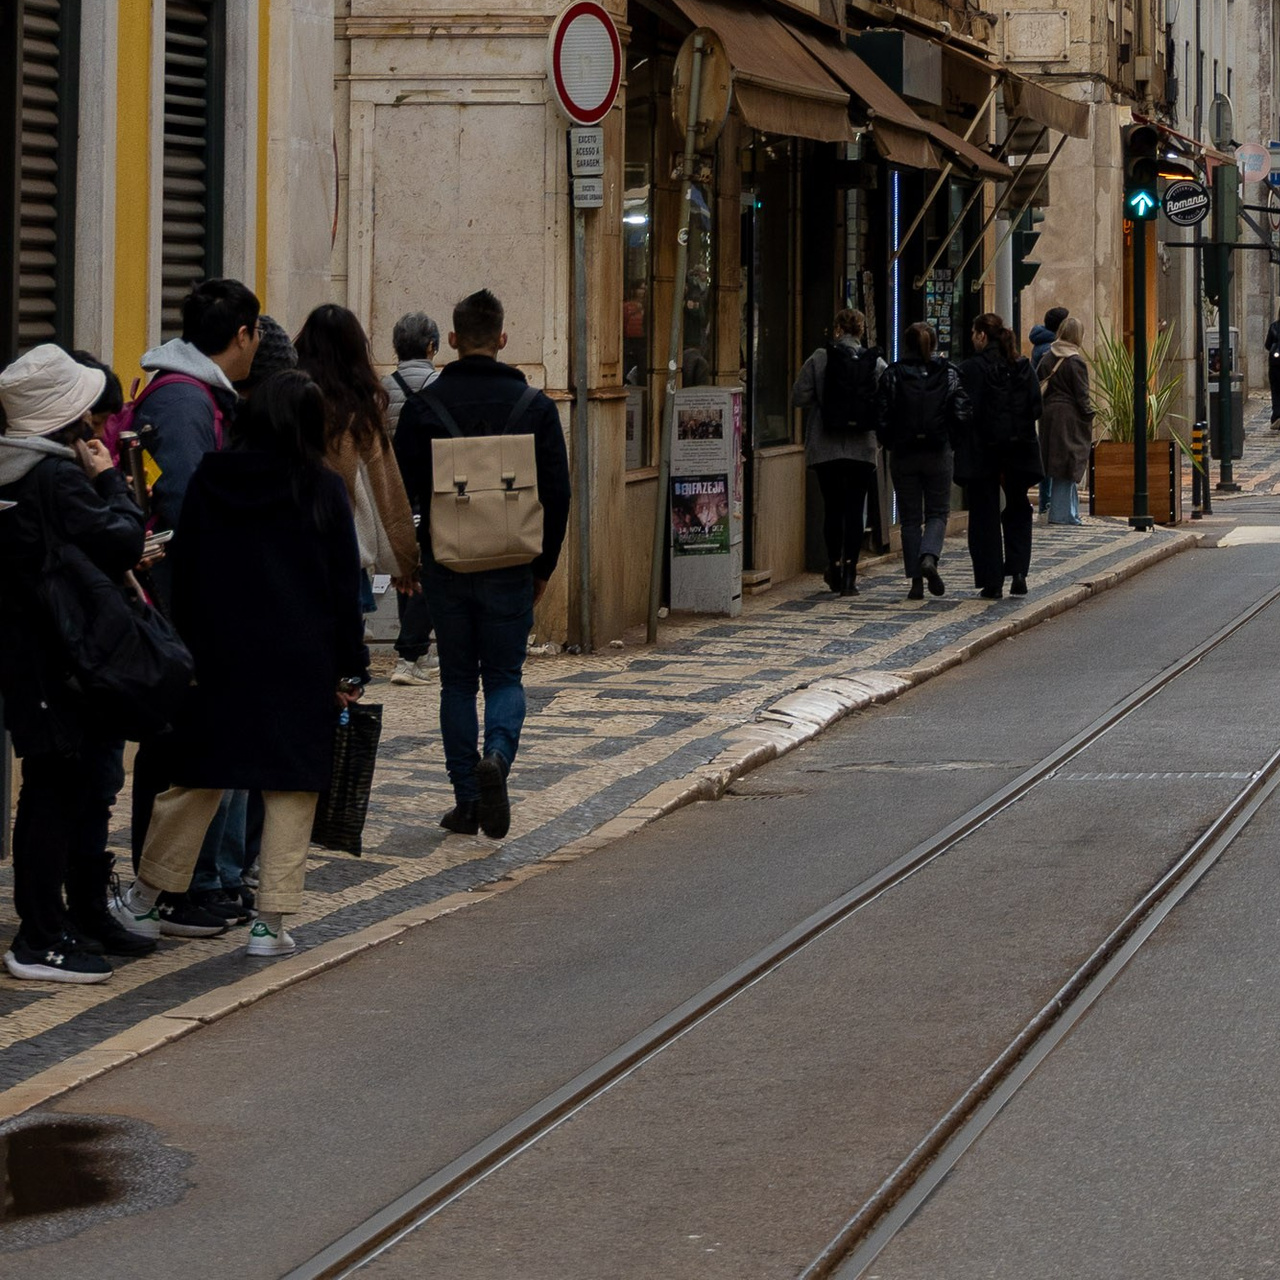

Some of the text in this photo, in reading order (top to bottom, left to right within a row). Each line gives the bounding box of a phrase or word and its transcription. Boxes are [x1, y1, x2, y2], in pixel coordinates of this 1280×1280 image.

[578, 135, 597, 144] EXCETO
[576, 147, 595, 156] ACESSO
[576, 158, 600, 168] GARAGEM
[1166, 194, 1207, 213] Romana
